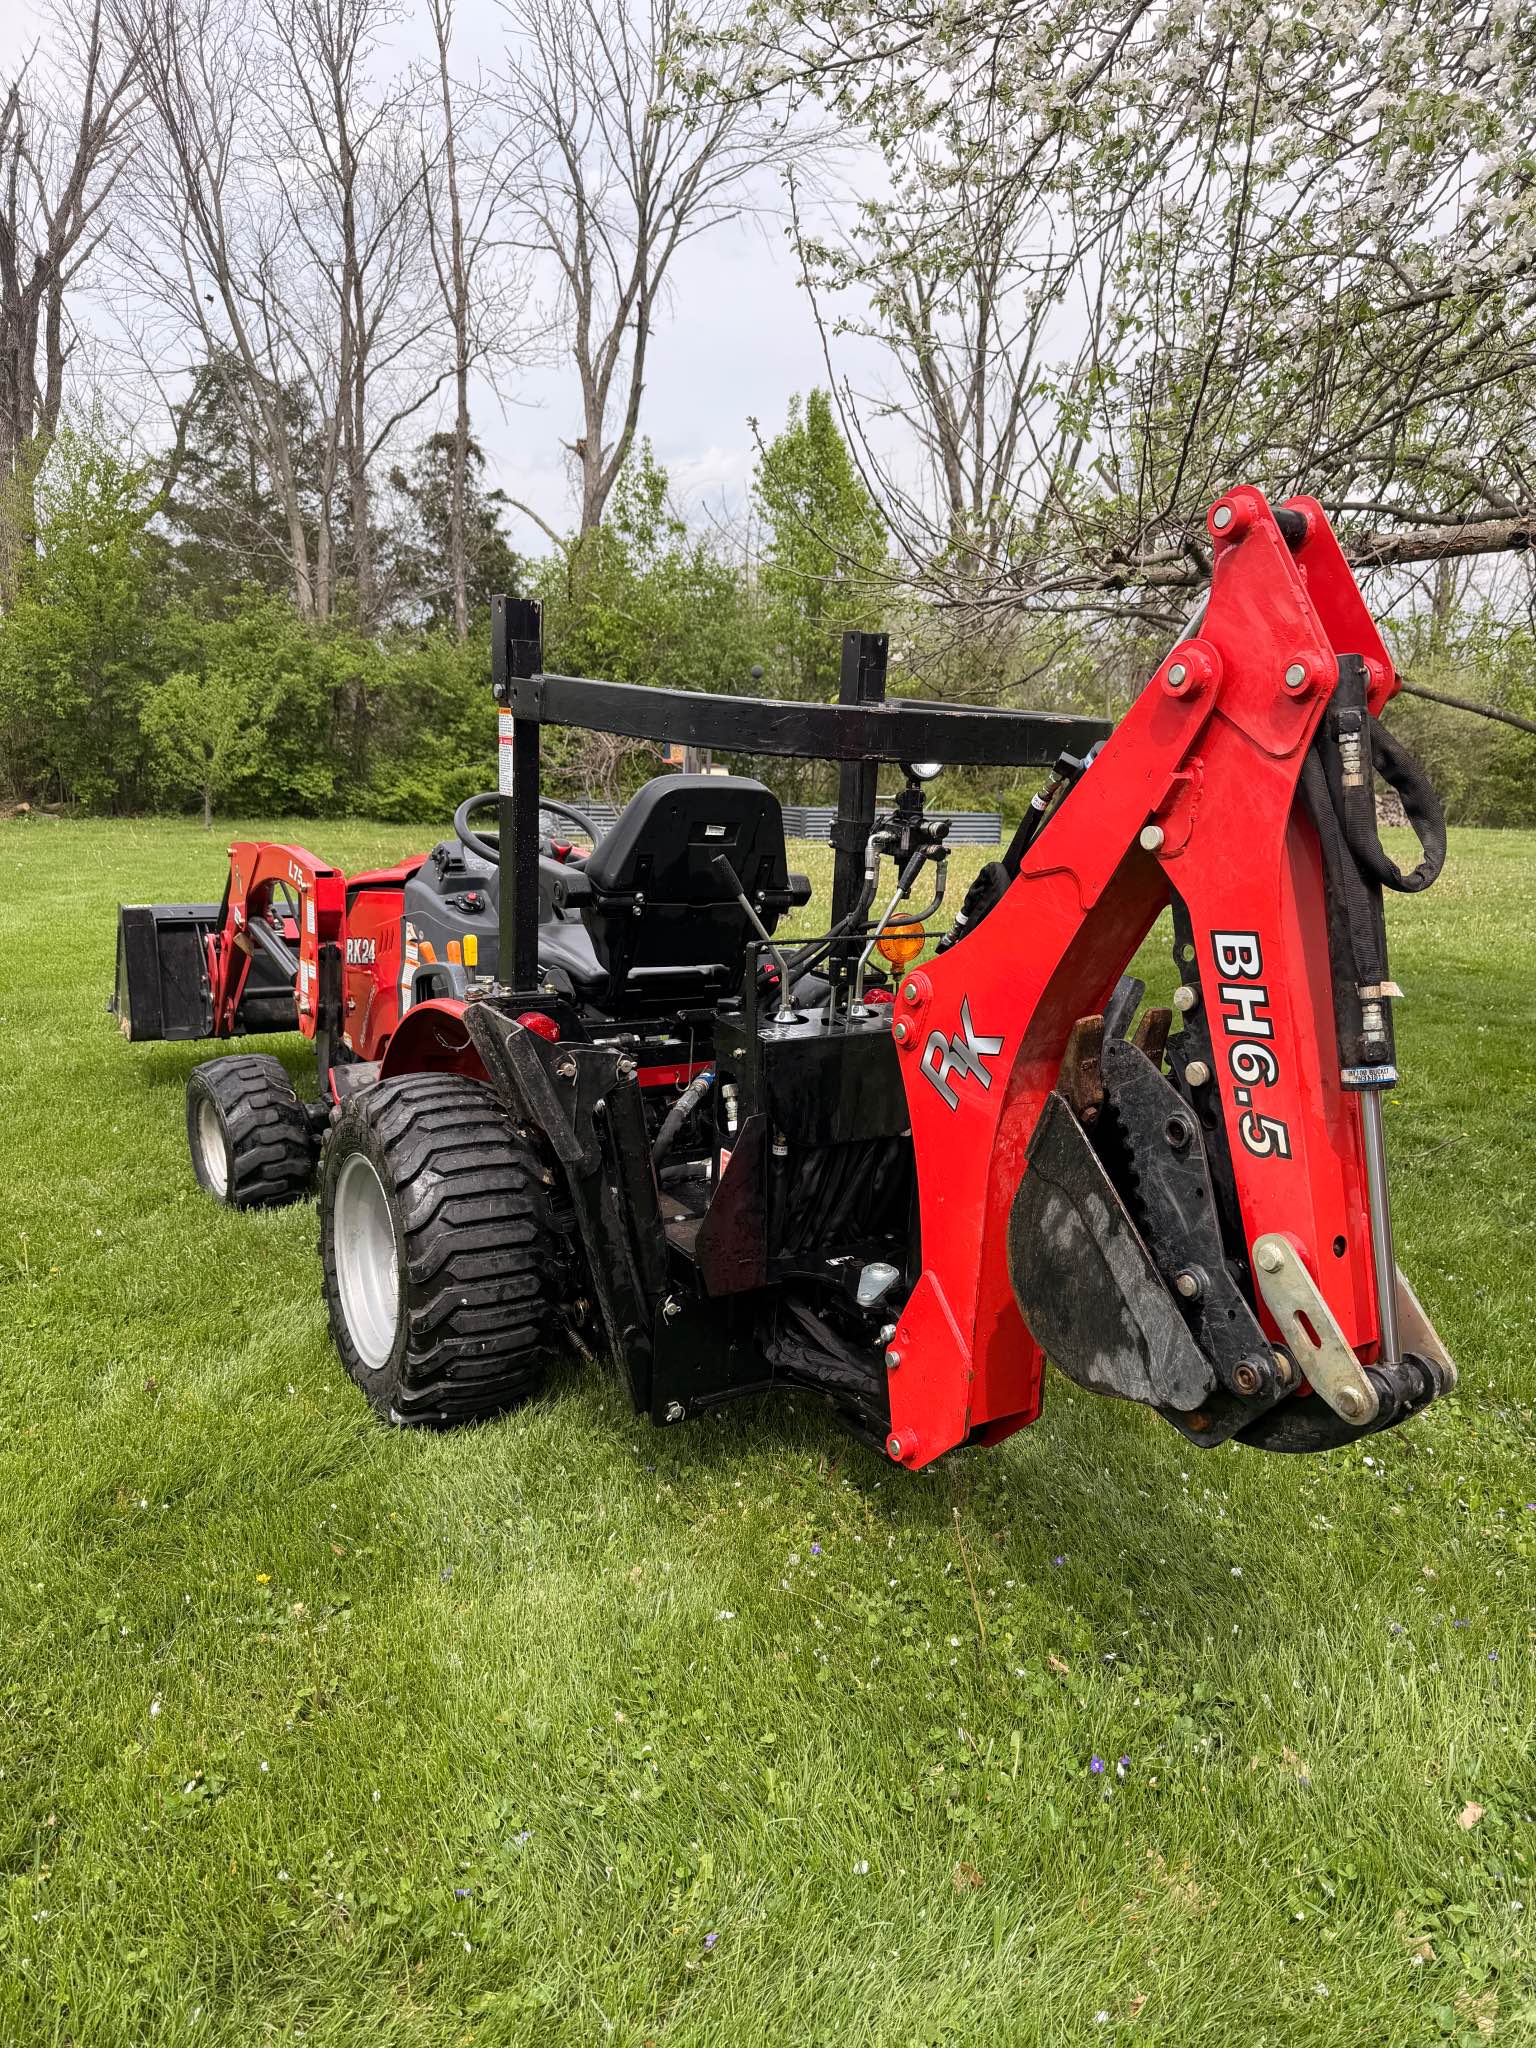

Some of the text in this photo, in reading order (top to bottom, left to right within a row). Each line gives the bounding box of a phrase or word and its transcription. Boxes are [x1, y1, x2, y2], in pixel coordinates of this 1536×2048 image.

[346, 938, 376, 964] RK24
[920, 993, 1005, 1111] RK
[1211, 931, 1293, 1160] BH6.5
